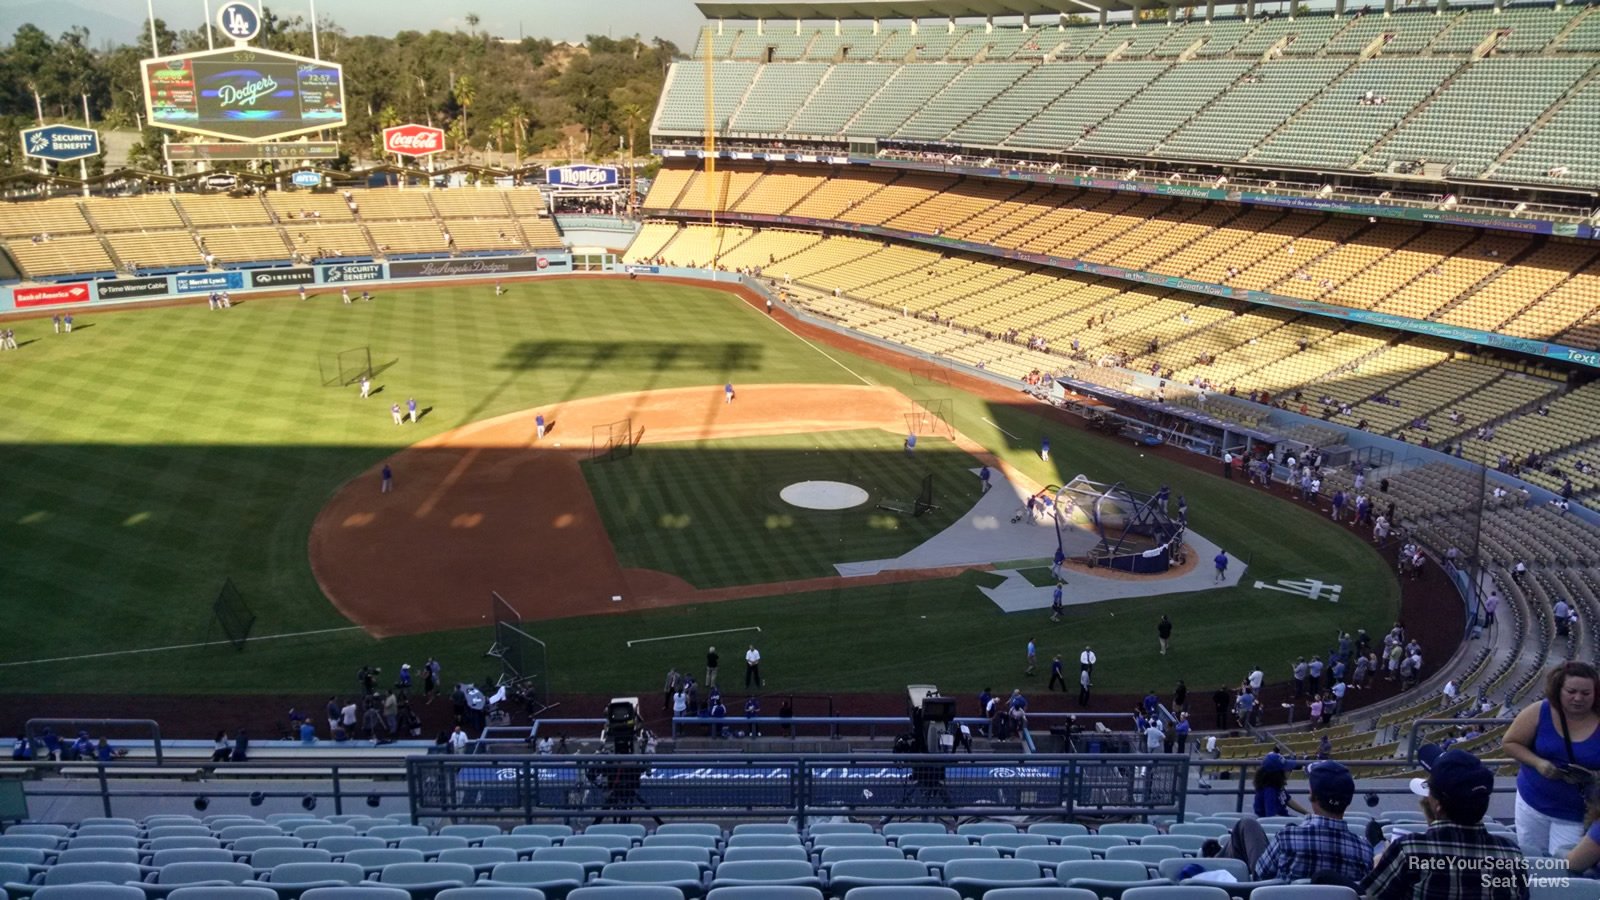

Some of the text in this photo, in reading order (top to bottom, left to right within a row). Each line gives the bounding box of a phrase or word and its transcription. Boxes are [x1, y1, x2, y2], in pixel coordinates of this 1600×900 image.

[227, 8, 250, 34] LA
[233, 53, 255, 61] 5:39
[218, 74, 278, 107] Dodgers
[51, 133, 93, 142] SECURITY
[1126, 183, 1137, 191] the
[1167, 186, 1191, 197] Donate
[342, 265, 380, 274] SECURITY
[439, 261, 472, 275] Angeles
[472, 260, 509, 273] Dodgers
[272, 273, 312, 281] INFINITI
[1125, 271, 1132, 279] in
[1132, 272, 1144, 280] the
[209, 277, 226, 285] Lynch
[147, 282, 166, 290] Cable
[1177, 280, 1204, 292] Donate
[1567, 349, 1596, 365] Text
